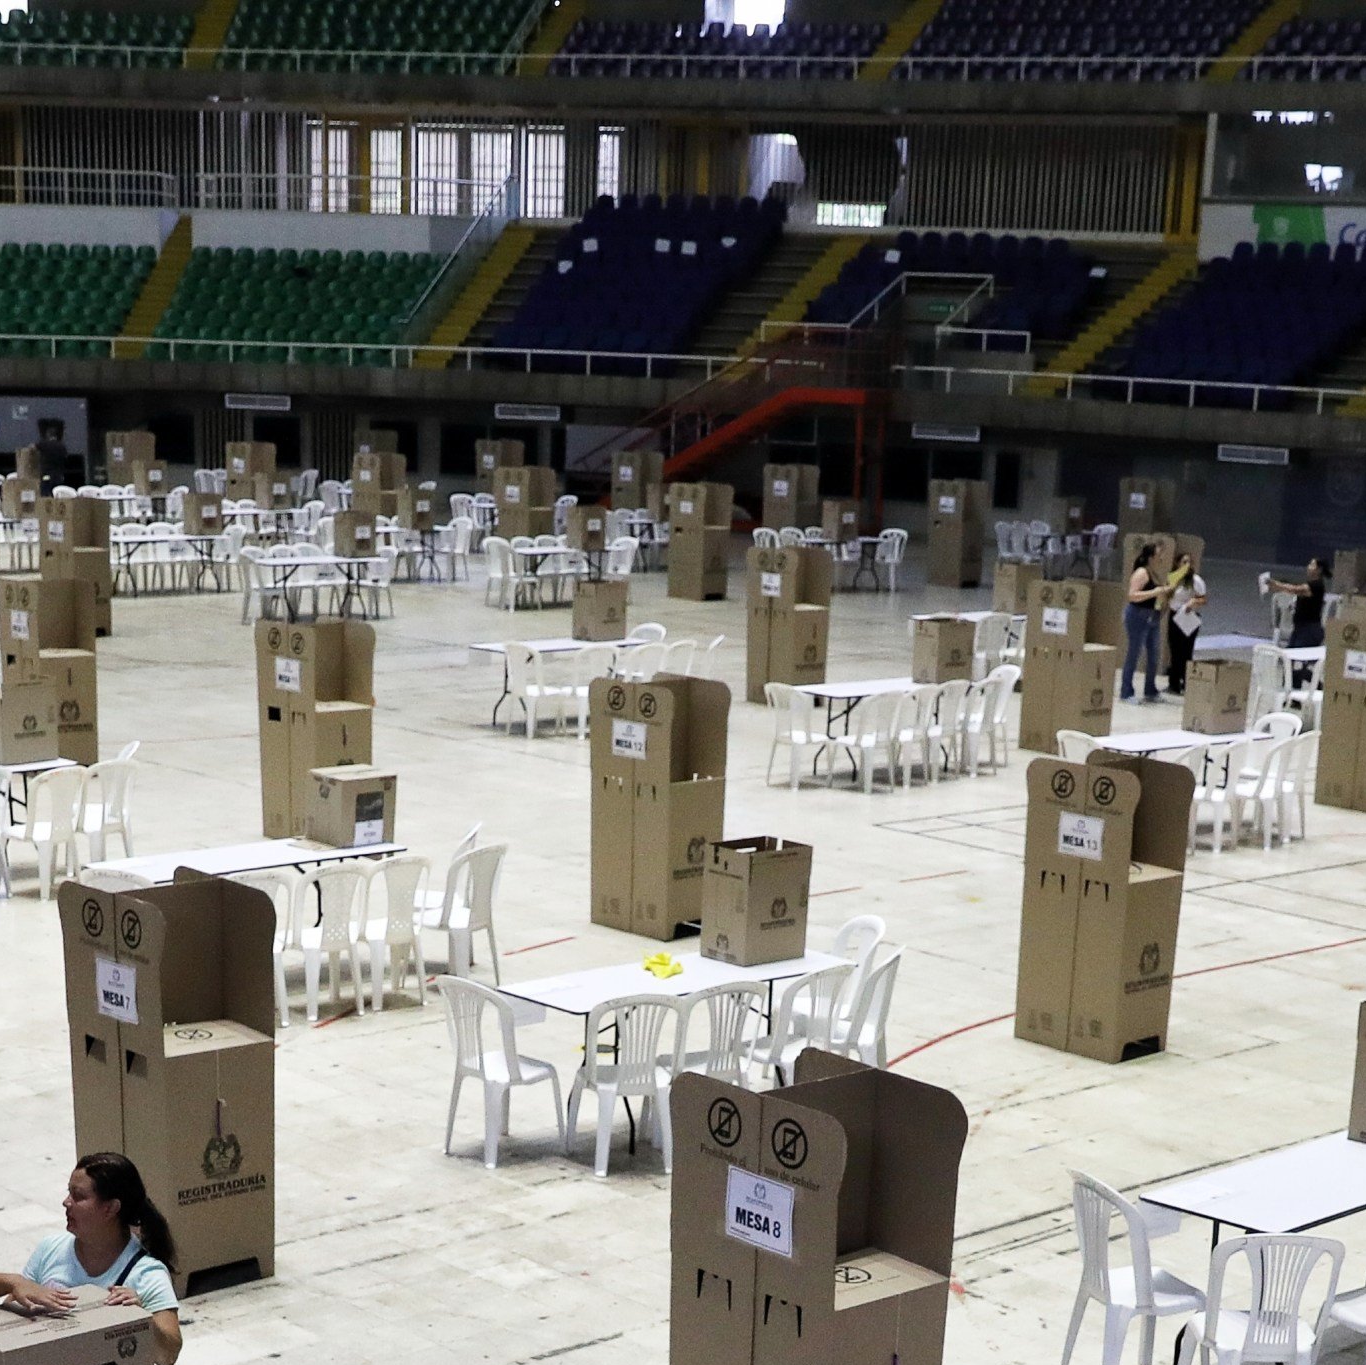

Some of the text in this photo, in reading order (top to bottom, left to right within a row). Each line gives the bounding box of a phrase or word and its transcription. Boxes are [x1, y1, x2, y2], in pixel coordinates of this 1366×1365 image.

[102, 989, 125, 1009] MESA
[177, 1172, 266, 1200] REGISTRADURÍA
[735, 1206, 770, 1237] MESA
[772, 1221, 782, 1239] 8
